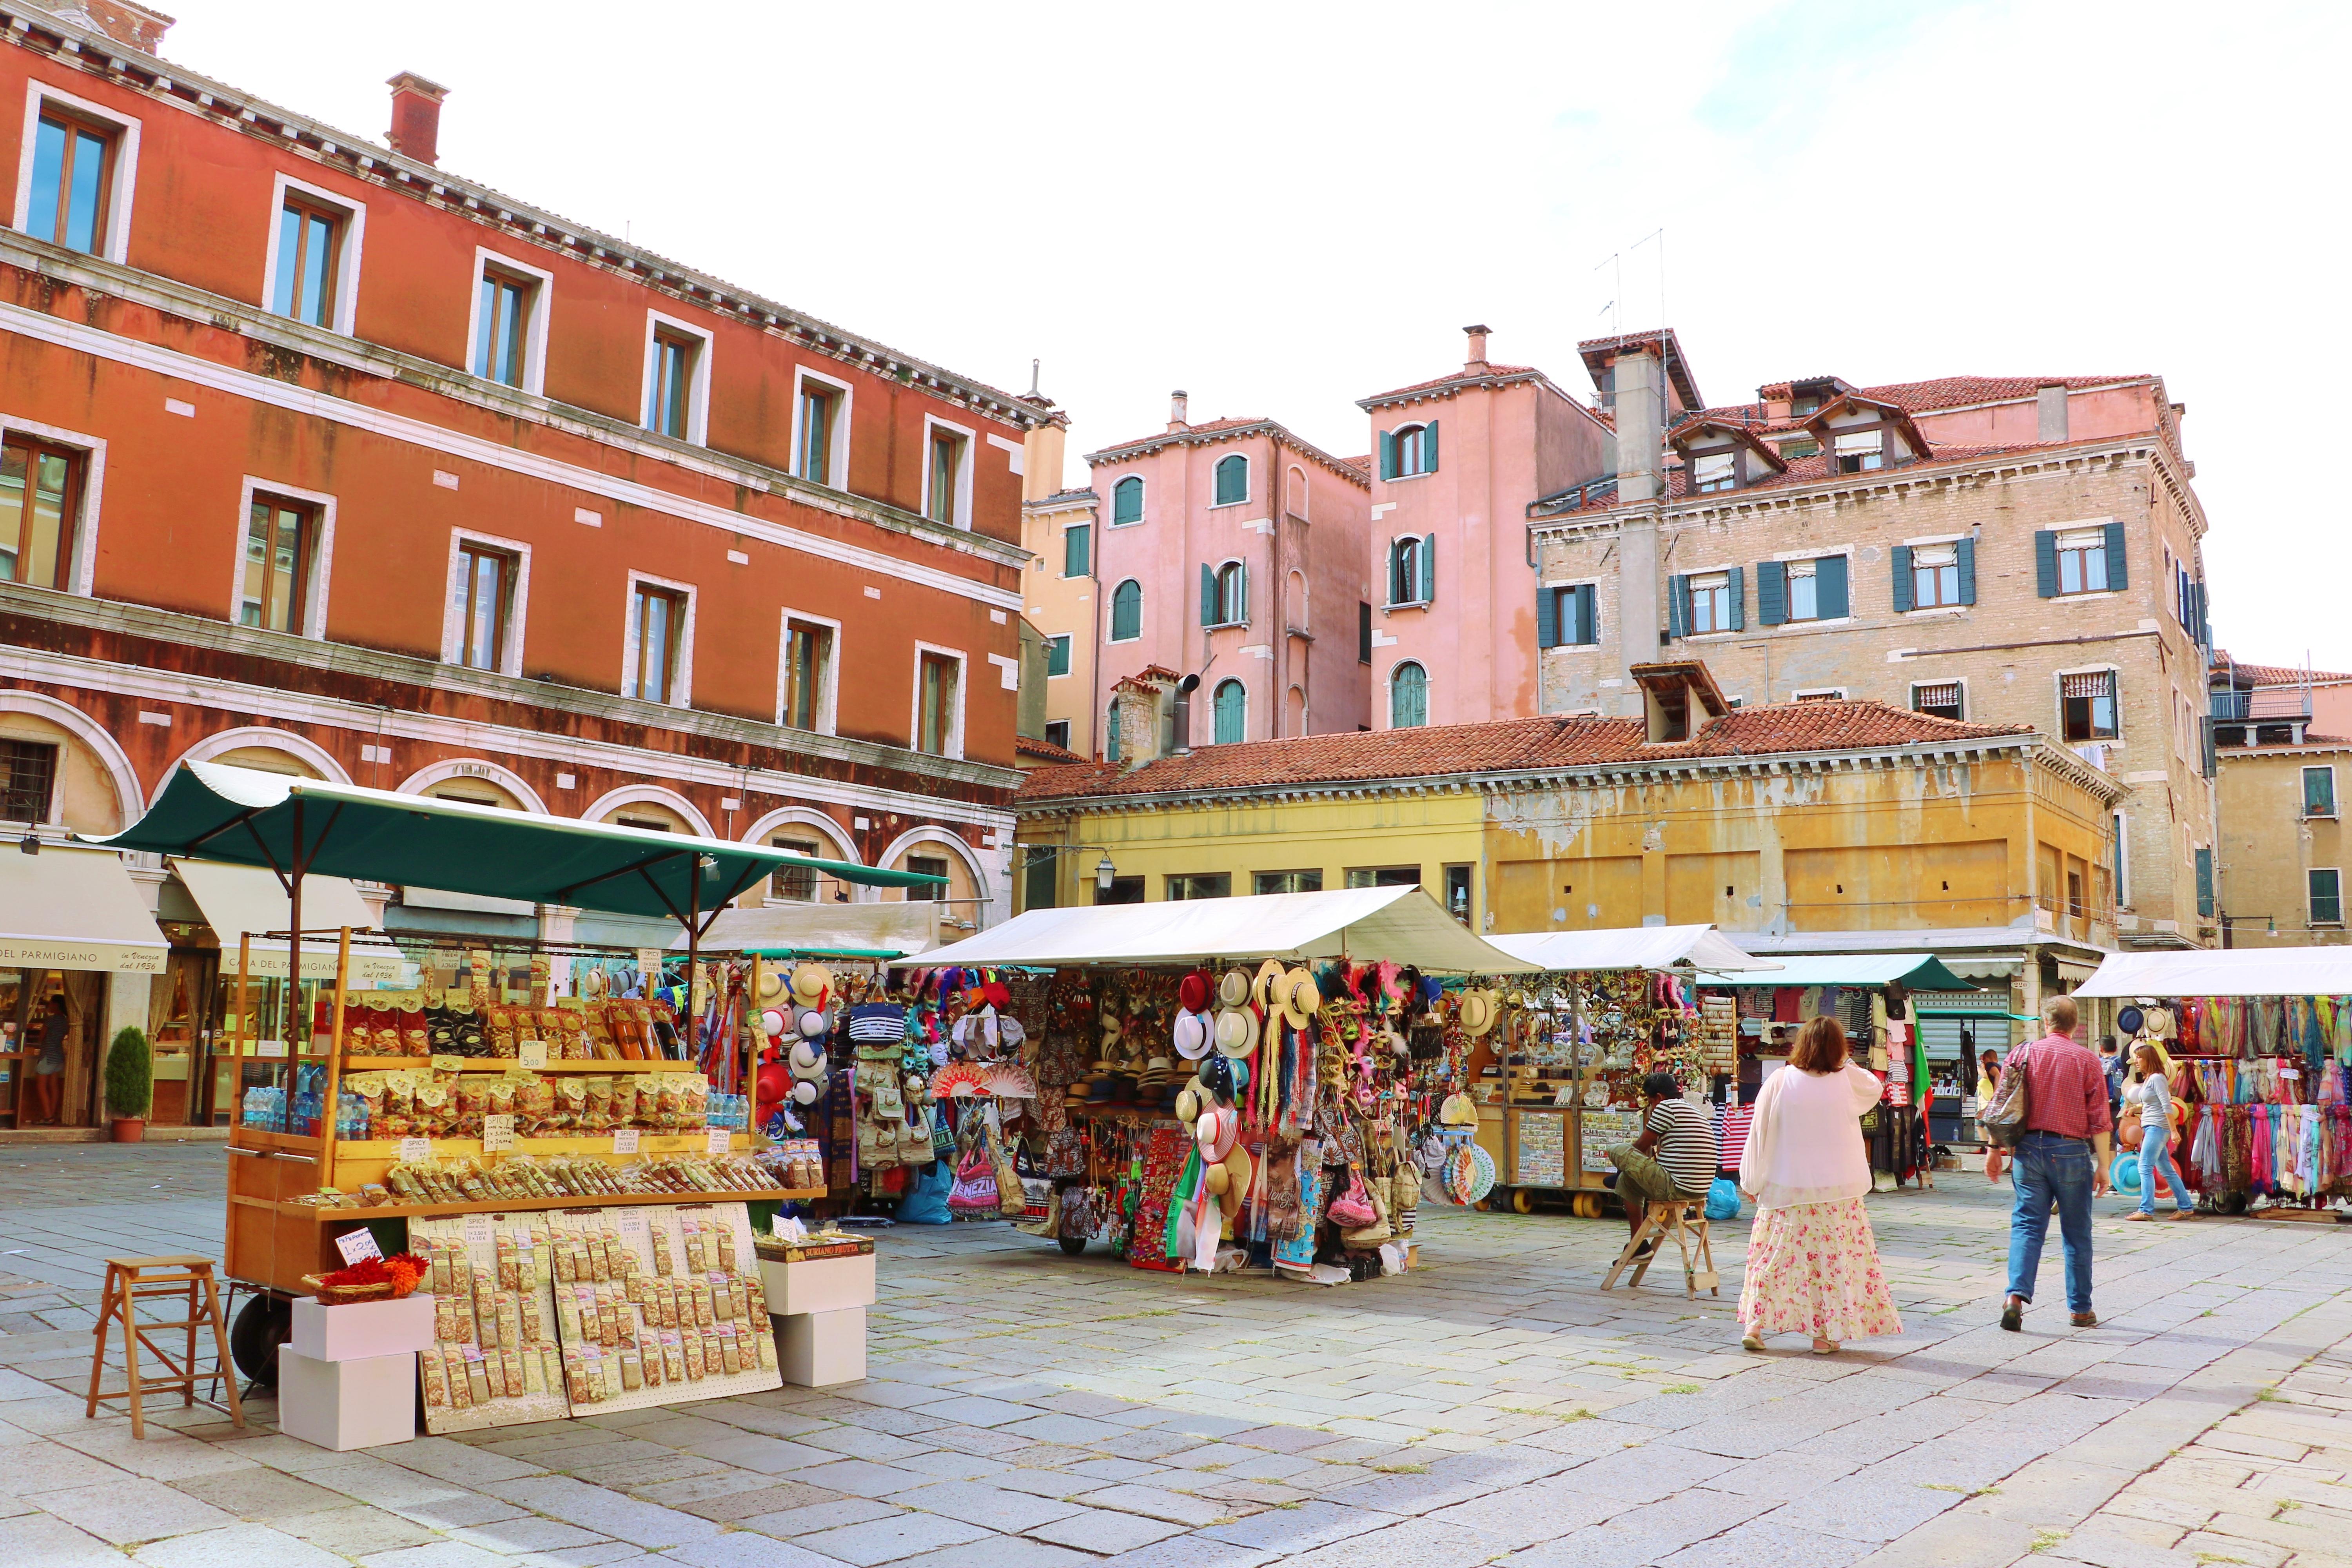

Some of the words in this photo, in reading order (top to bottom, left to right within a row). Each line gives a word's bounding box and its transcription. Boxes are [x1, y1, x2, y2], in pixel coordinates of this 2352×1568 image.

[22, 951, 97, 962] PARMIGIANO
[131, 952, 160, 961] Venezia
[229, 958, 256, 967] CA
[282, 962, 339, 971] PAMIGIAN
[488, 1116, 511, 1127] SPICY
[952, 1179, 998, 1197] VENEZIA
[806, 1246, 834, 1257] SURIANO
[835, 1243, 858, 1254] FRUTTA
